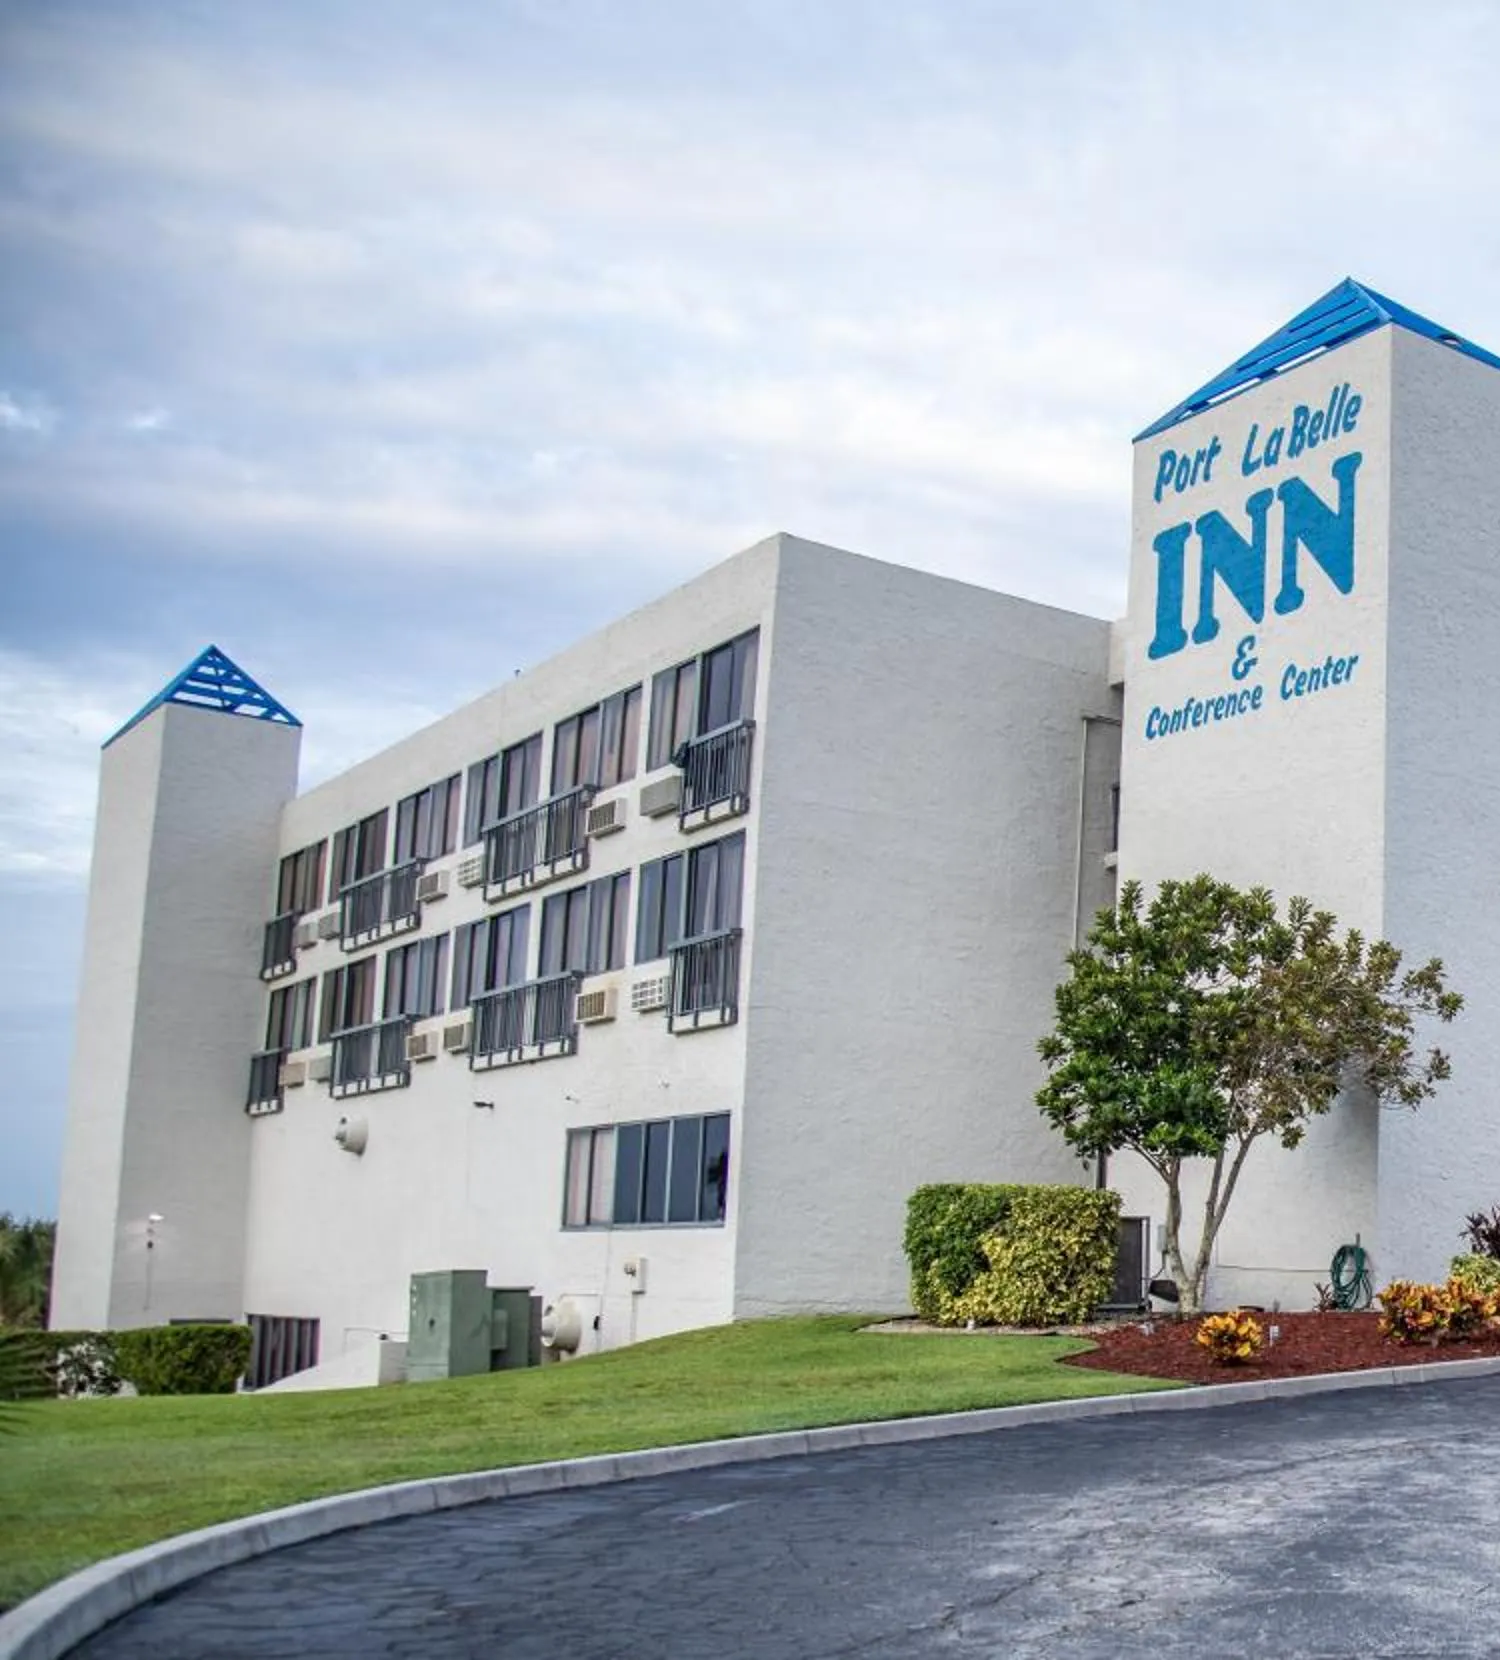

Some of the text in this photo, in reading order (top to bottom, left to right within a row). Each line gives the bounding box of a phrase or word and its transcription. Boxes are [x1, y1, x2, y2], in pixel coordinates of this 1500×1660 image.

[1153, 382, 1364, 504] Port LaBelle
[1147, 451, 1363, 661] INN
[1144, 653, 1360, 740] Conference Center
[1231, 634, 1258, 681] &
